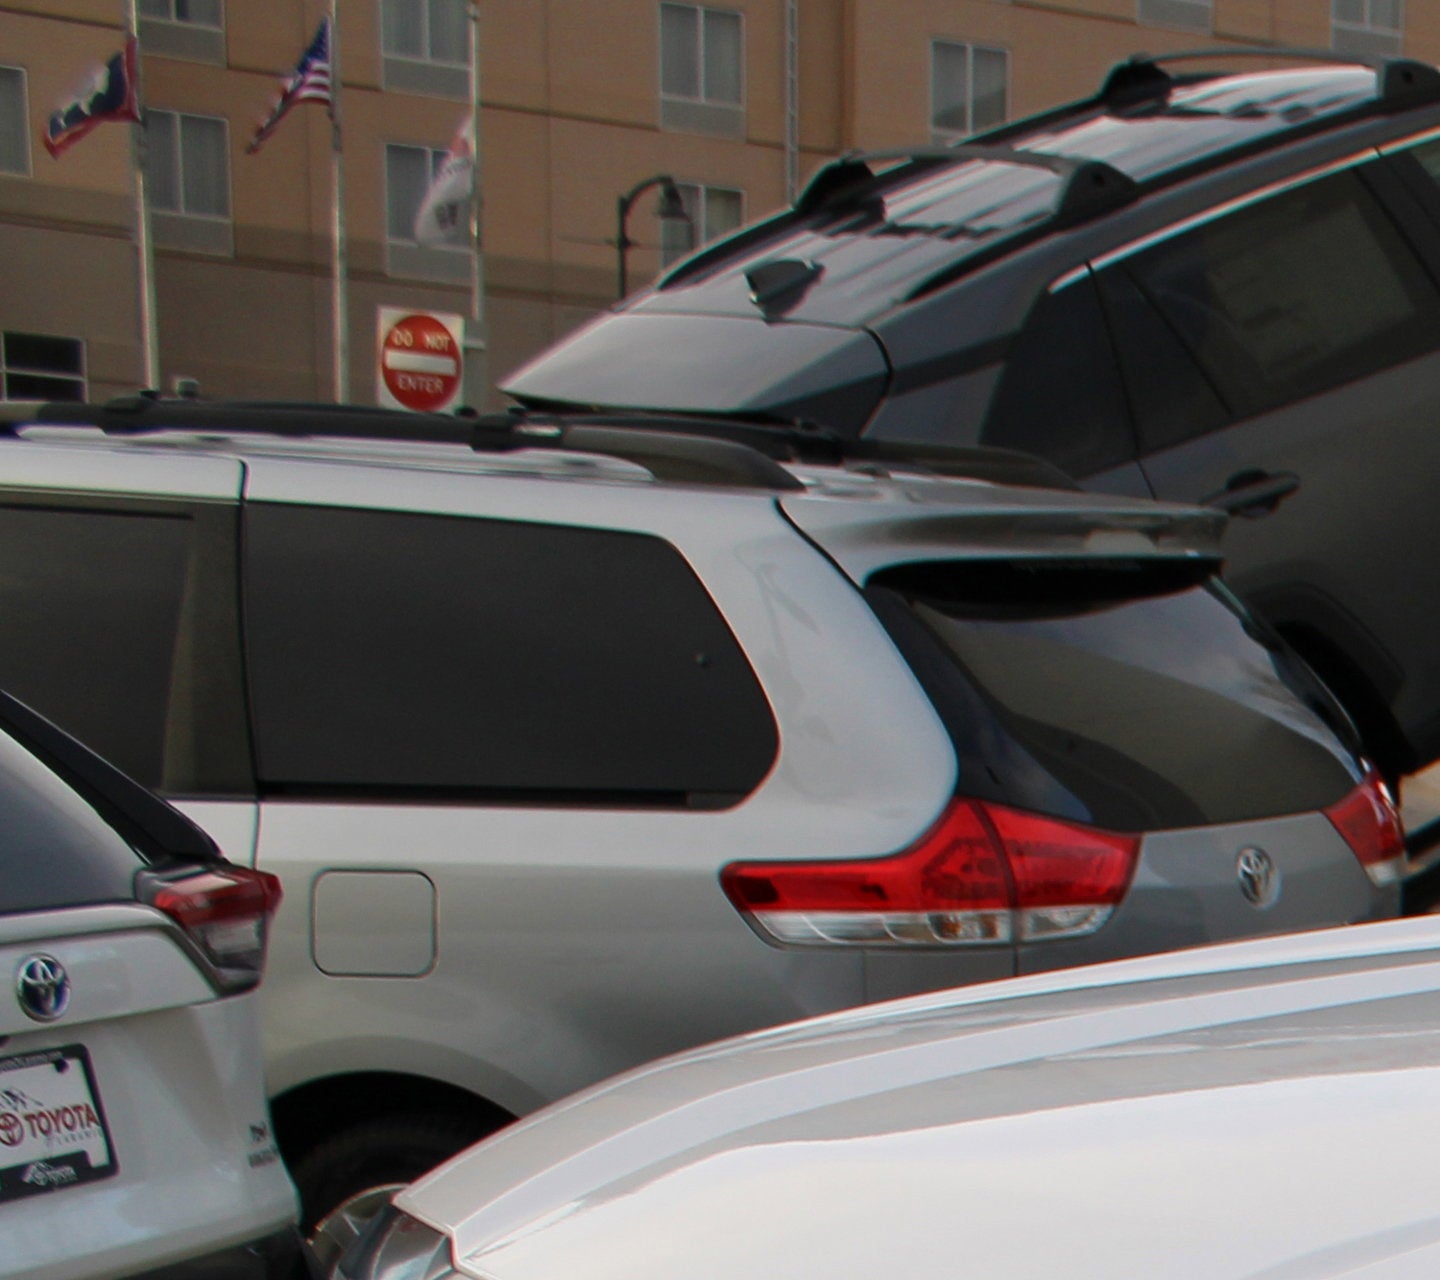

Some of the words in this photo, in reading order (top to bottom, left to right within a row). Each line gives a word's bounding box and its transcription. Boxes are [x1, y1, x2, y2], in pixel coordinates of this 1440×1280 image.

[392, 328, 414, 347] DO
[422, 331, 450, 352] NOT
[397, 374, 444, 394] ENTER
[24, 1103, 100, 1138] TOYOTA
